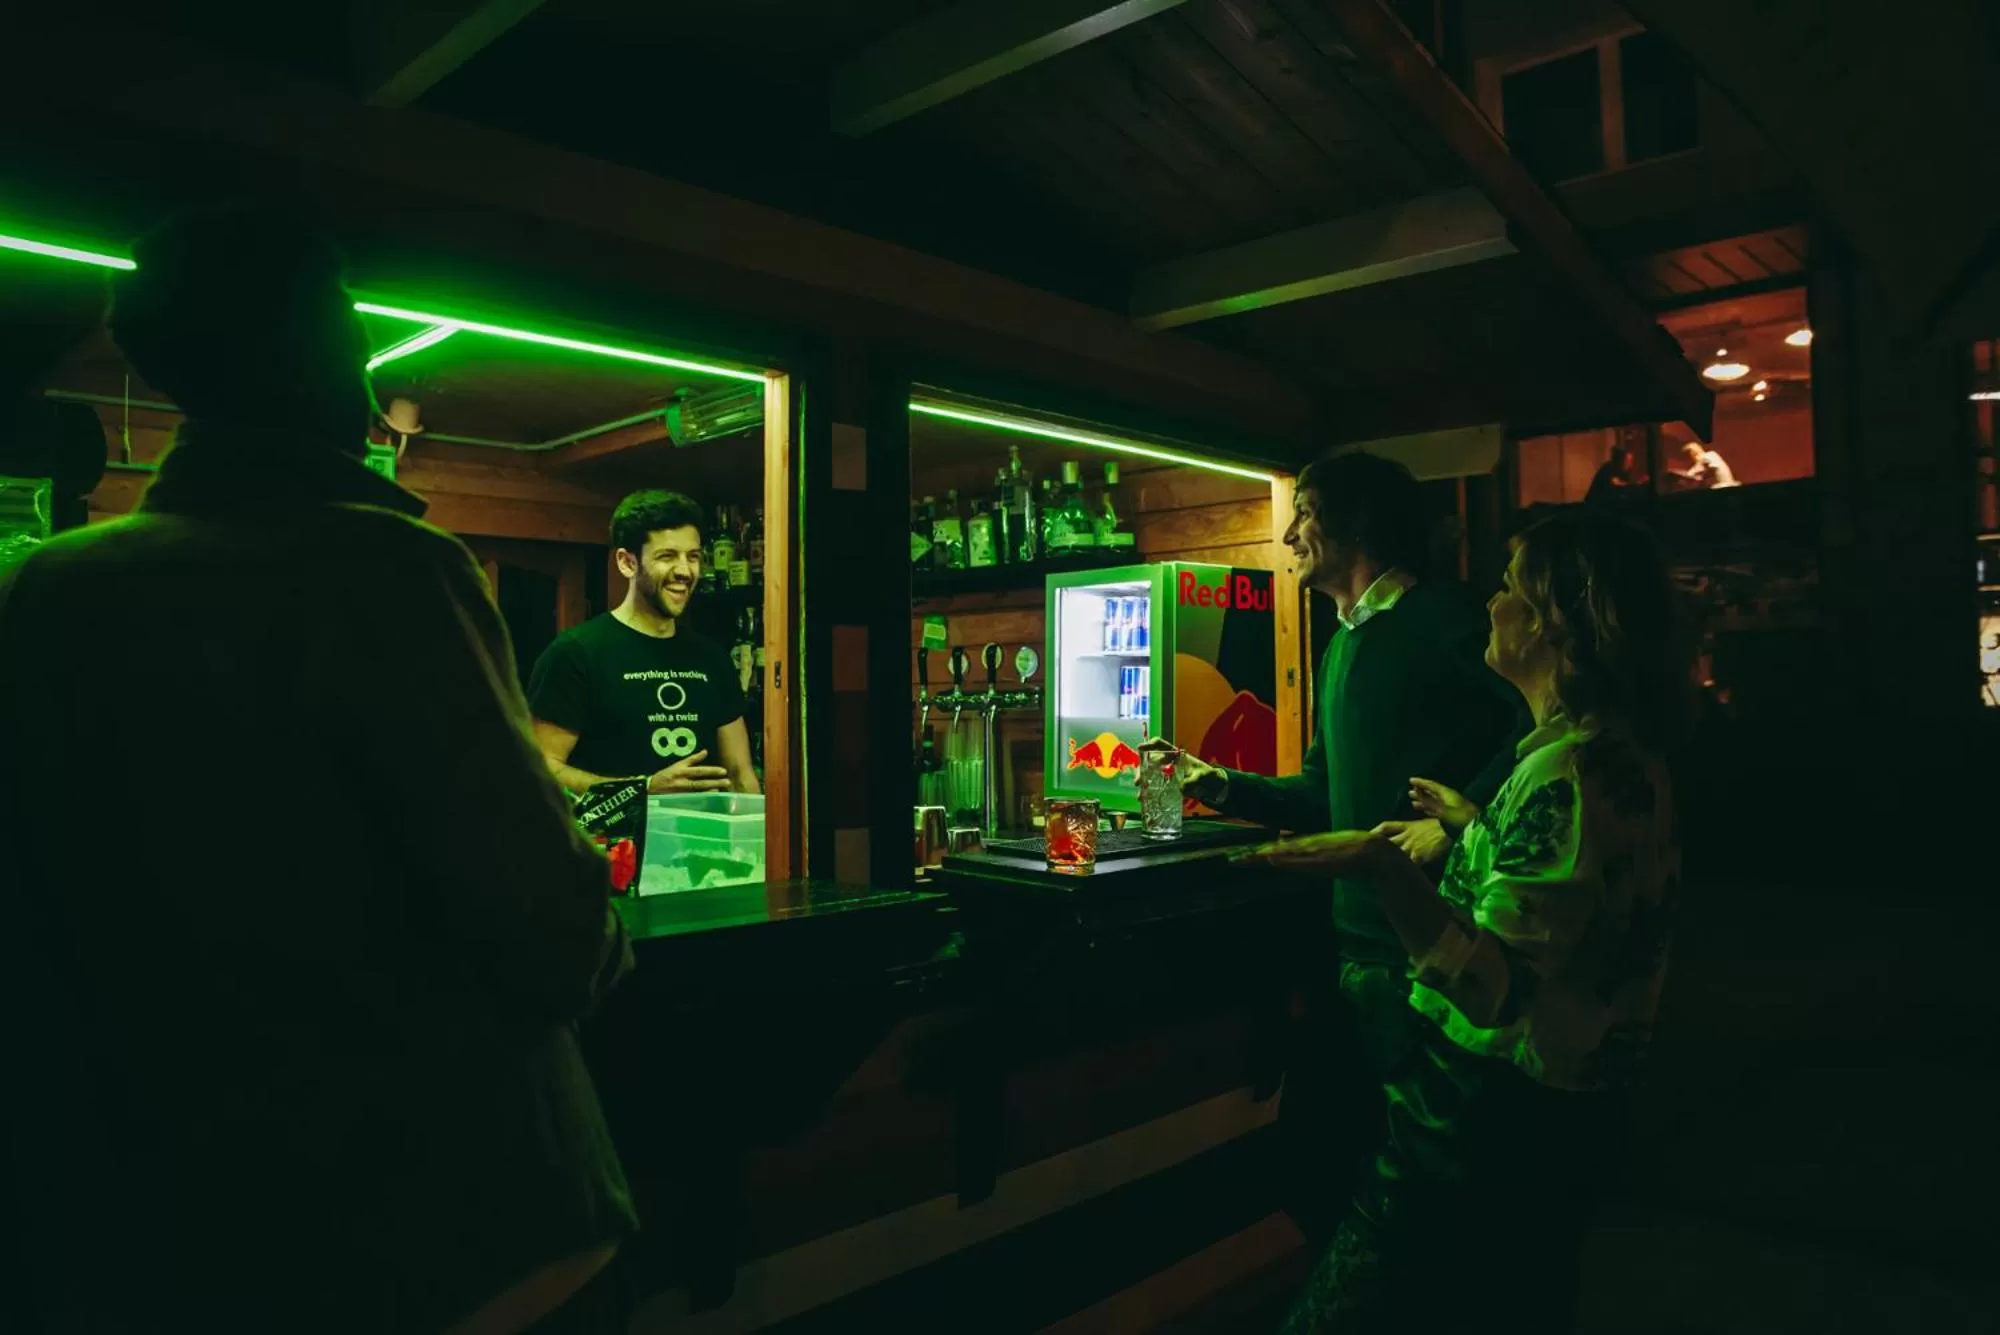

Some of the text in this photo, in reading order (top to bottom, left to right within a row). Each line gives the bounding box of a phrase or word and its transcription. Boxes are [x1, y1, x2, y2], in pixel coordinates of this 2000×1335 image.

[1178, 570, 1275, 612] Red Bul
[623, 670, 670, 681] everything
[647, 712, 698, 722] with a twist
